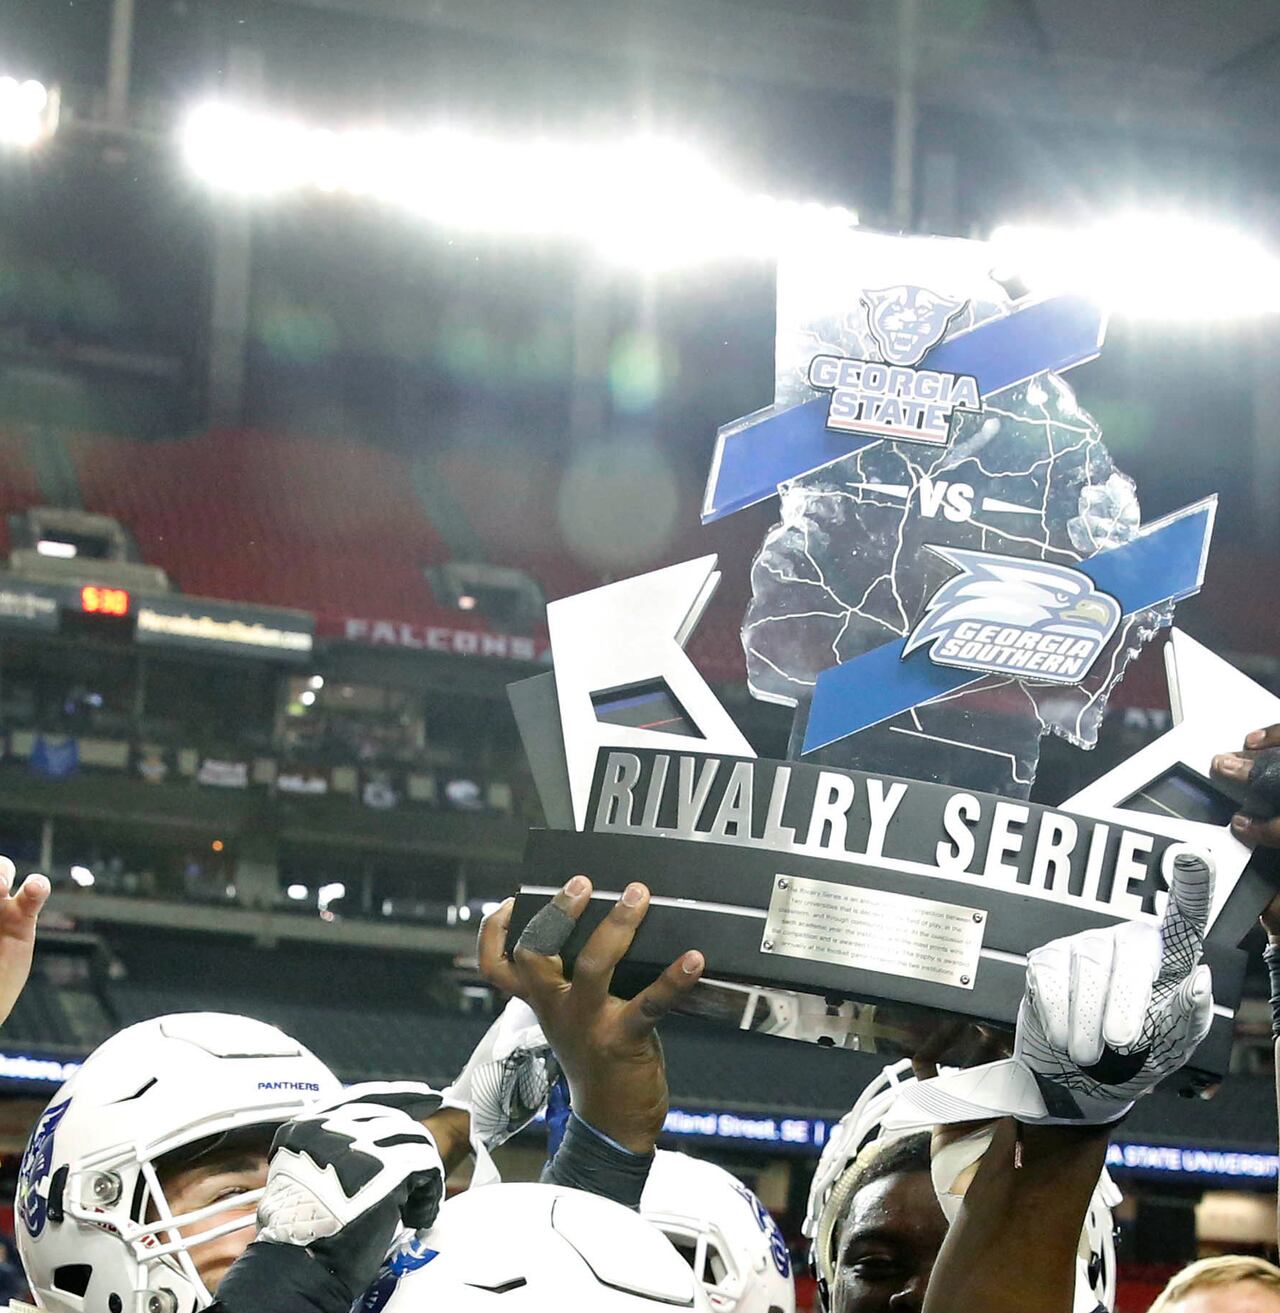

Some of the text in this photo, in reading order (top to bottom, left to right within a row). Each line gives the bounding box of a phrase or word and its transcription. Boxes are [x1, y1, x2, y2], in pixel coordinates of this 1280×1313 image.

[811, 358, 979, 408] GEORGIA
[831, 391, 952, 430] STATE
[920, 479, 975, 522] VS
[345, 617, 536, 660] FALCONS
[939, 637, 1084, 676] SOUTHERN
[952, 621, 1096, 659] GEORGIA
[595, 751, 909, 861] RIVALRY
[257, 1081, 320, 1092] PANTHERS
